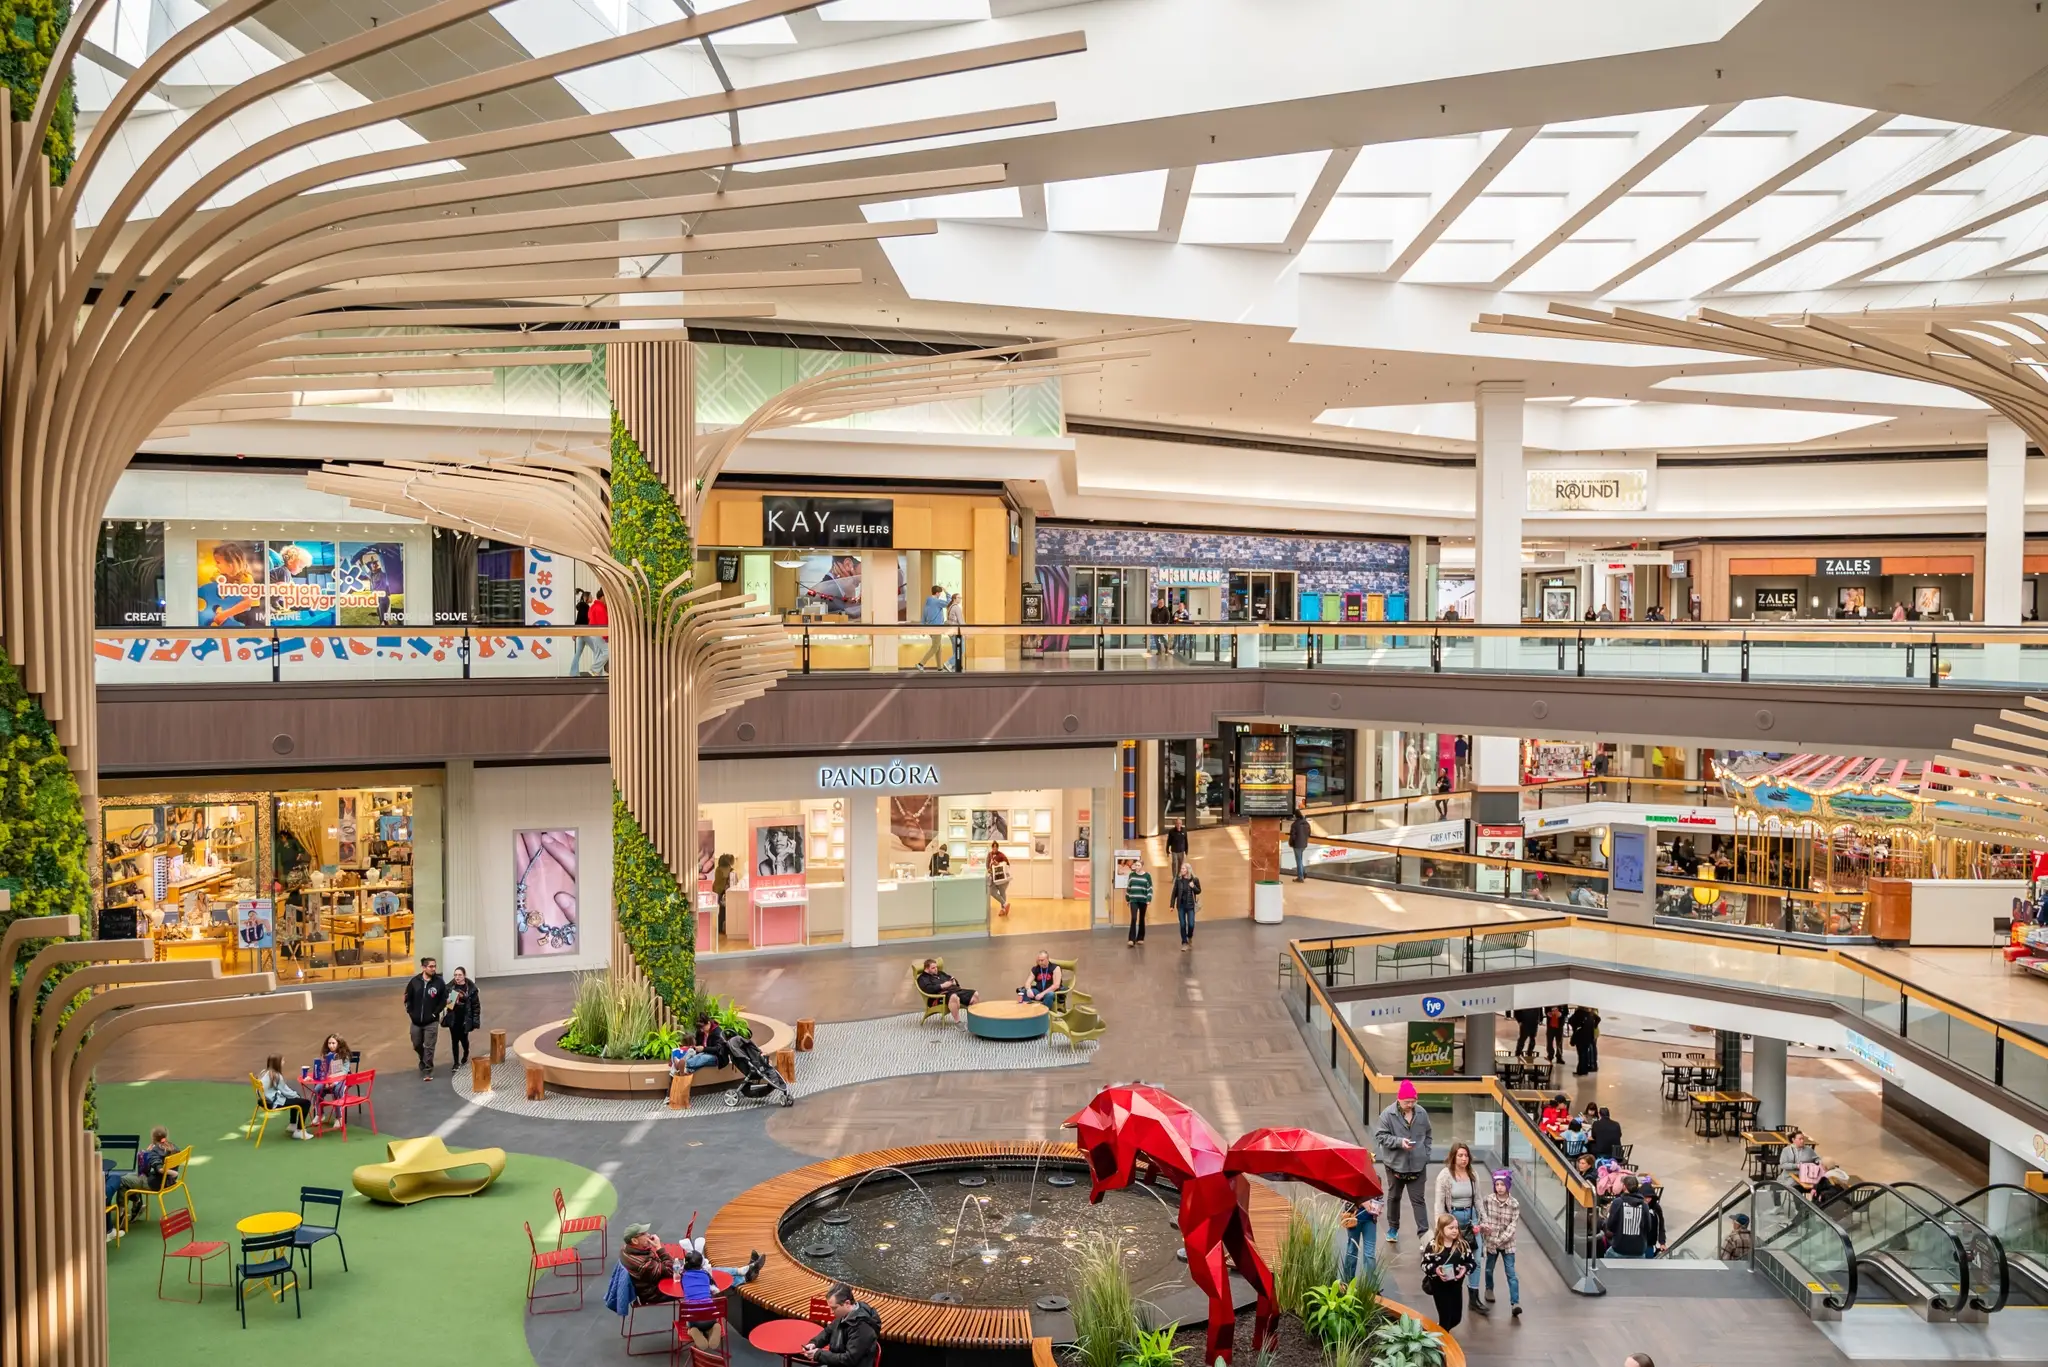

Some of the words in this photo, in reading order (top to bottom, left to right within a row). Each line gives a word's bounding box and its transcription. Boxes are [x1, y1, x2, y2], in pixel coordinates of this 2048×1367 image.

[768, 510, 831, 532] KAY
[833, 524, 889, 534] JEWELERS
[1826, 560, 1870, 571] ZALES
[1188, 569, 1220, 583] MASH
[217, 575, 320, 600] imagination
[284, 590, 380, 611] playground
[1758, 593, 1796, 604] ZALES
[124, 612, 167, 622] CREATE
[255, 612, 302, 621] IMAGINE
[435, 612, 468, 621] SOLVE
[821, 762, 939, 787] PANDORA
[121, 822, 236, 849] Bghton
[1430, 831, 1451, 843] GREAT
[1371, 1006, 1402, 1017] MUSIC
[1426, 1000, 1441, 1013] fye
[1411, 1041, 1438, 1055] Taste
[1412, 1045, 1450, 1062] world
